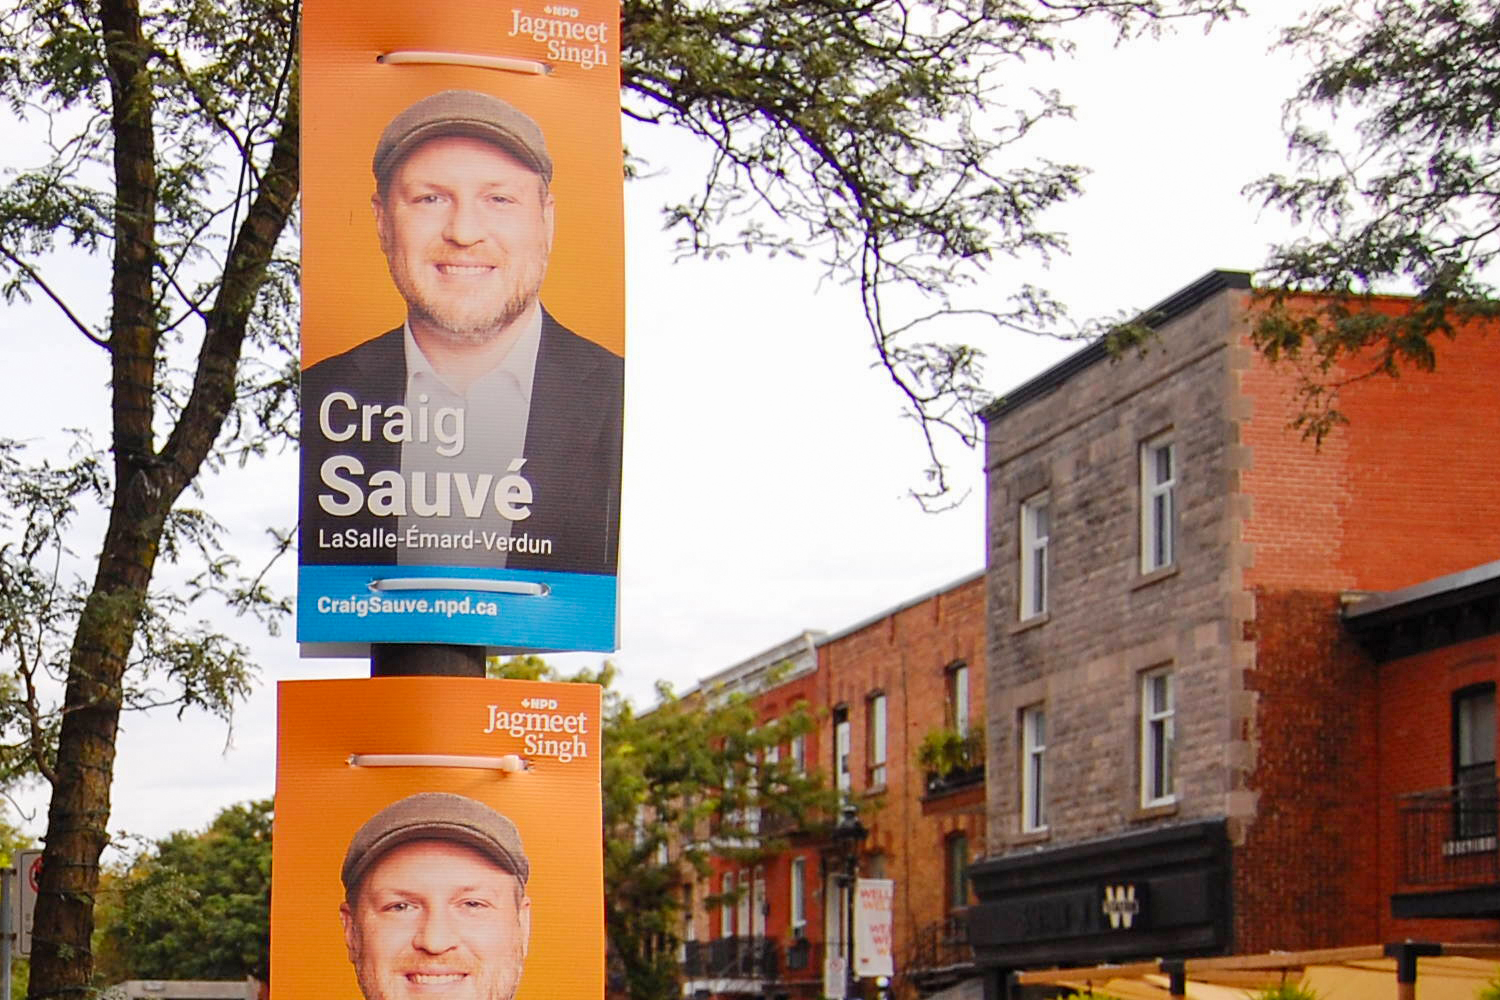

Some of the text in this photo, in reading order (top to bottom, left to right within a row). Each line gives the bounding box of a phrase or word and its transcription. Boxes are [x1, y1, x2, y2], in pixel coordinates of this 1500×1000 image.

[508, 10, 608, 44] Jagmeet
[553, 6, 579, 18] NPD
[546, 40, 608, 69] Singh
[319, 391, 466, 457] Craig
[318, 455, 534, 521] Sauvé
[318, 525, 553, 556] LaSalle-Émard-Verdun
[317, 596, 498, 617] CraigSauve.npd.ca
[530, 699, 557, 710] NPD
[484, 705, 588, 737] Jagmeet
[524, 734, 588, 763] Singh
